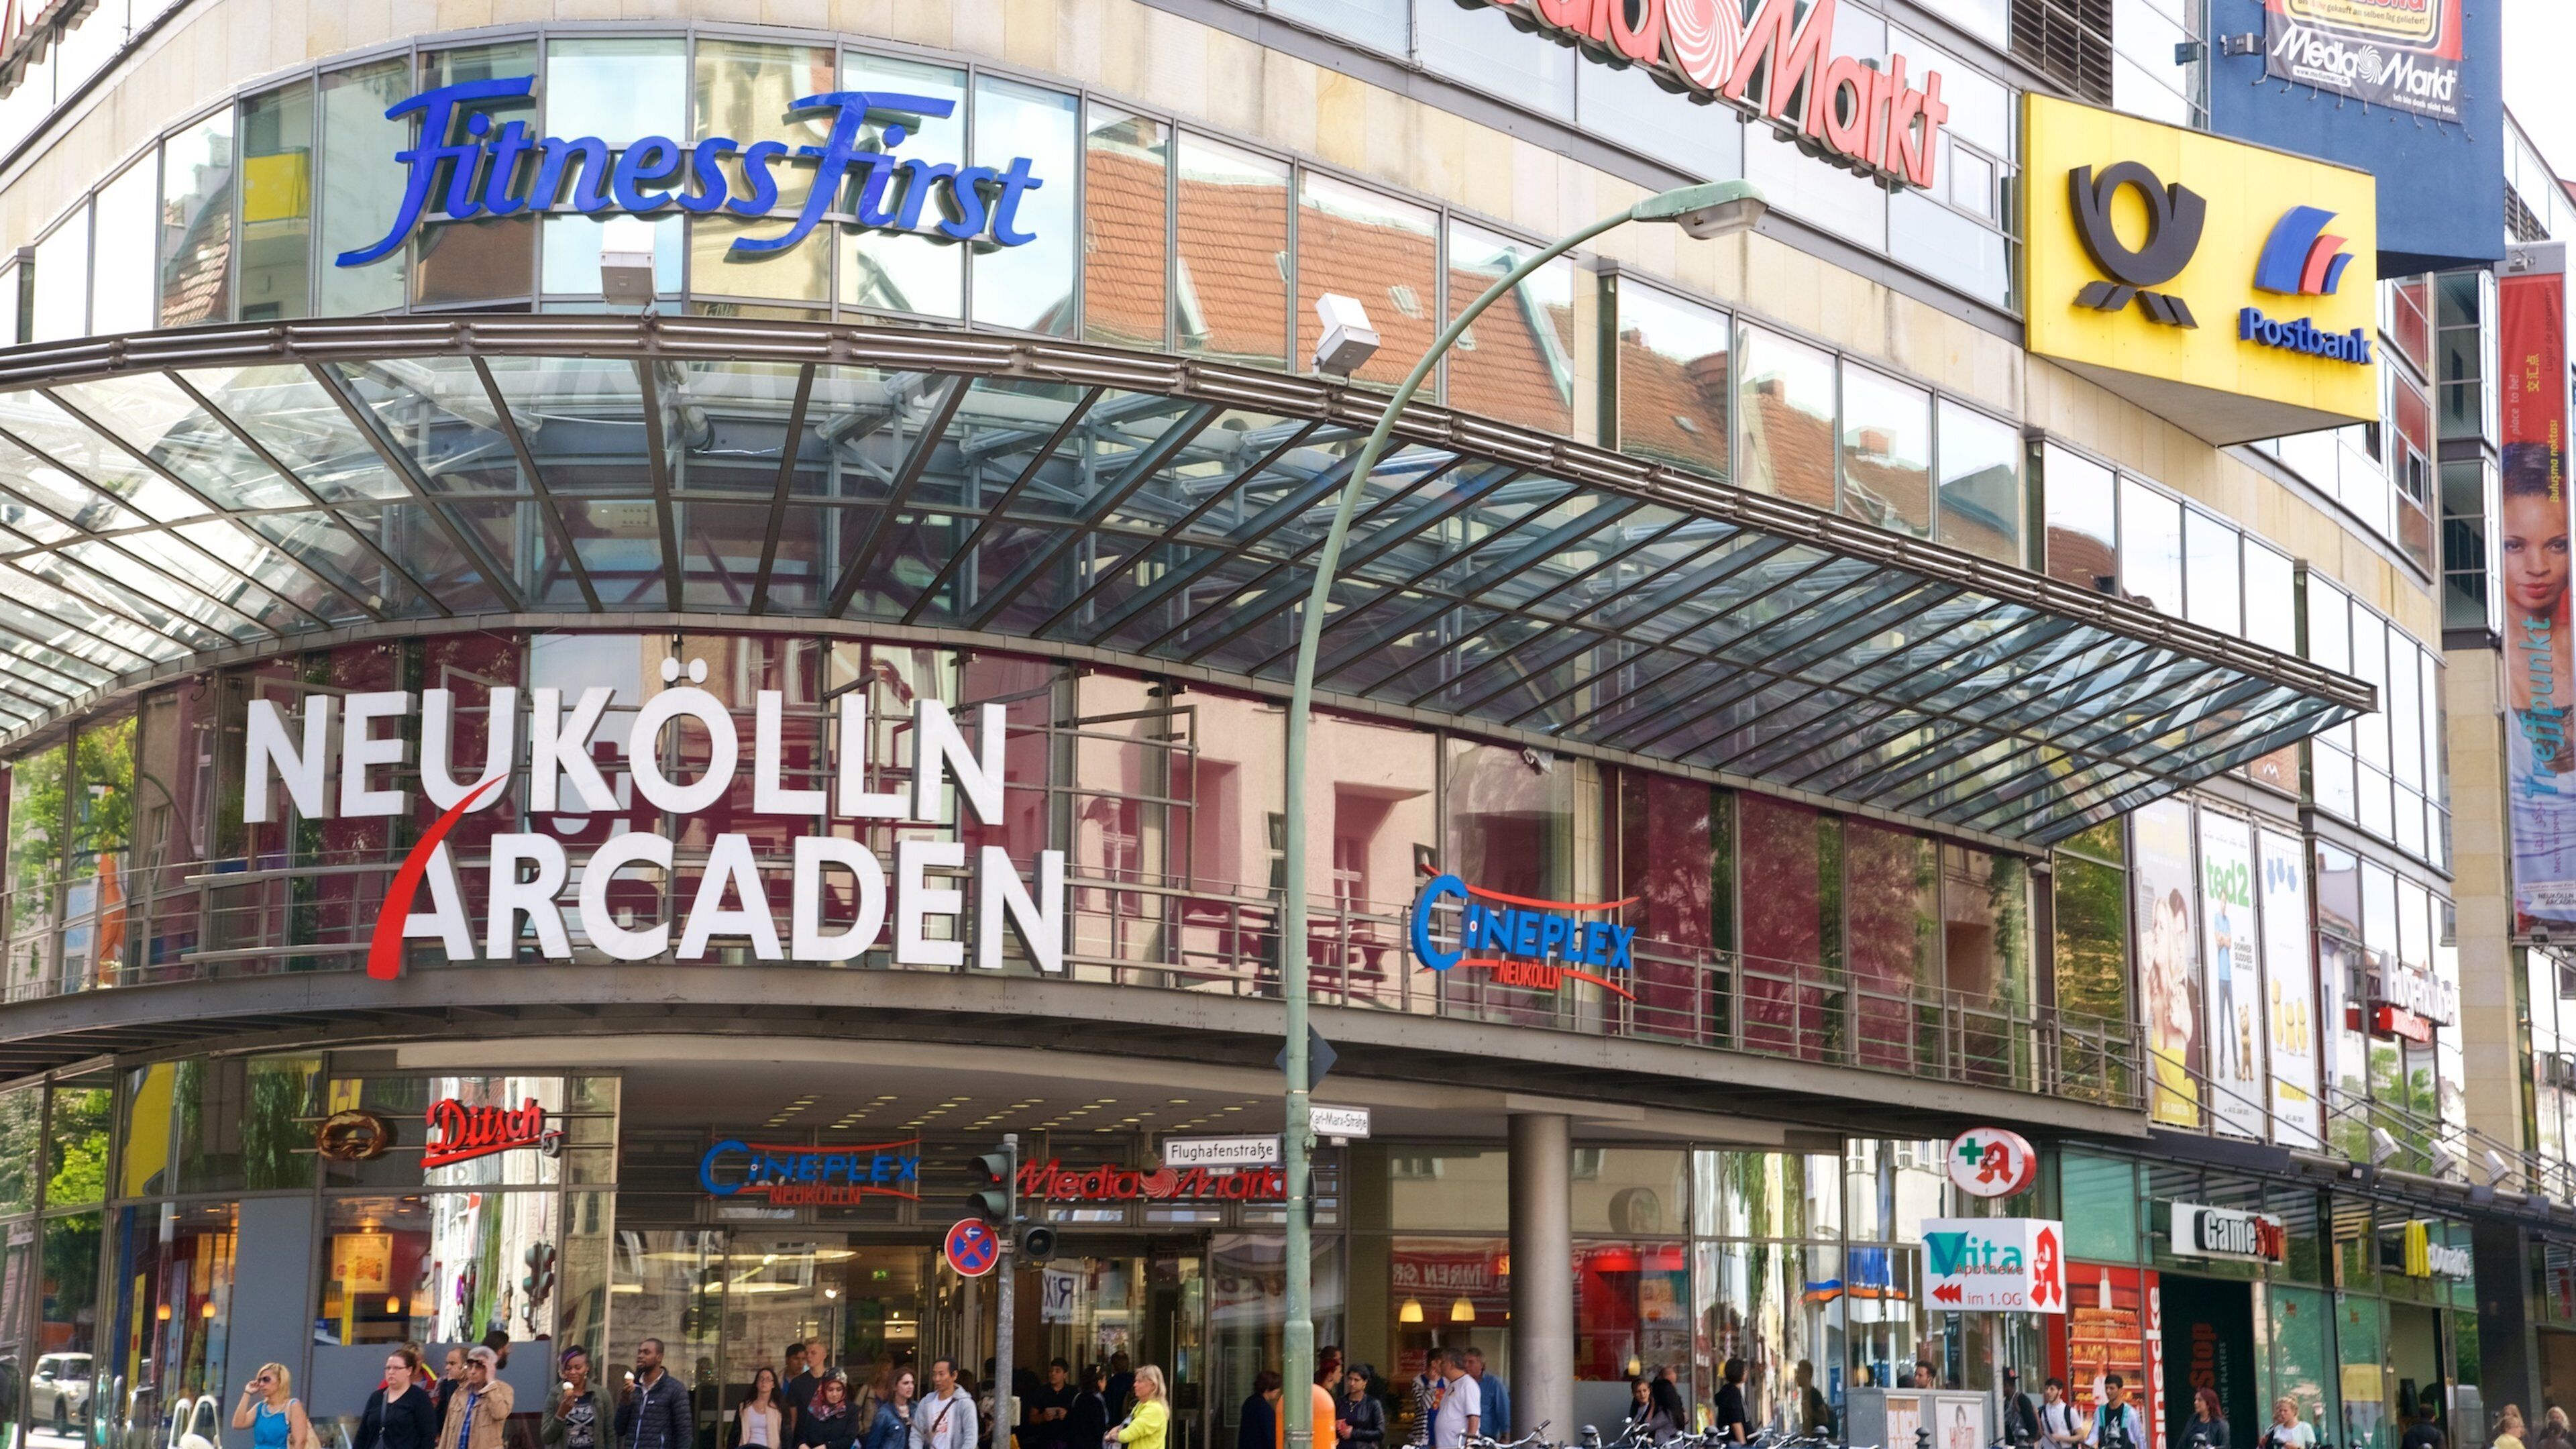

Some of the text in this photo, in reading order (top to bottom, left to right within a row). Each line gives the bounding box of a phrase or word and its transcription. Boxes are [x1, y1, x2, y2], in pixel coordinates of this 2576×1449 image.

[2272, 24, 2457, 101] Media Markt
[335, 74, 1043, 267] Fitness First
[2239, 307, 2374, 365] Postbank
[2526, 354, 2540, 392] 交汇点
[2510, 392, 2520, 403] to
[2509, 408, 2522, 435] place
[2519, 615, 2565, 799] Treffpunkt
[242, 657, 1008, 825] NEUKÖLLN
[366, 830, 1066, 980] ARCADEN
[1495, 959, 1562, 990] NEUKÖLLN
[425, 1097, 542, 1153] Ditsch
[1171, 1142, 1273, 1161] Flughafenstraße
[769, 1181, 861, 1205] NEUKÖLLN
[1016, 1159, 1141, 1199] Media
[1923, 1230, 2023, 1279] Vita
[1955, 1263, 2024, 1277] Apotheke
[1968, 1292, 1984, 1305] im
[2218, 1341, 2229, 1383] PLAYERS
